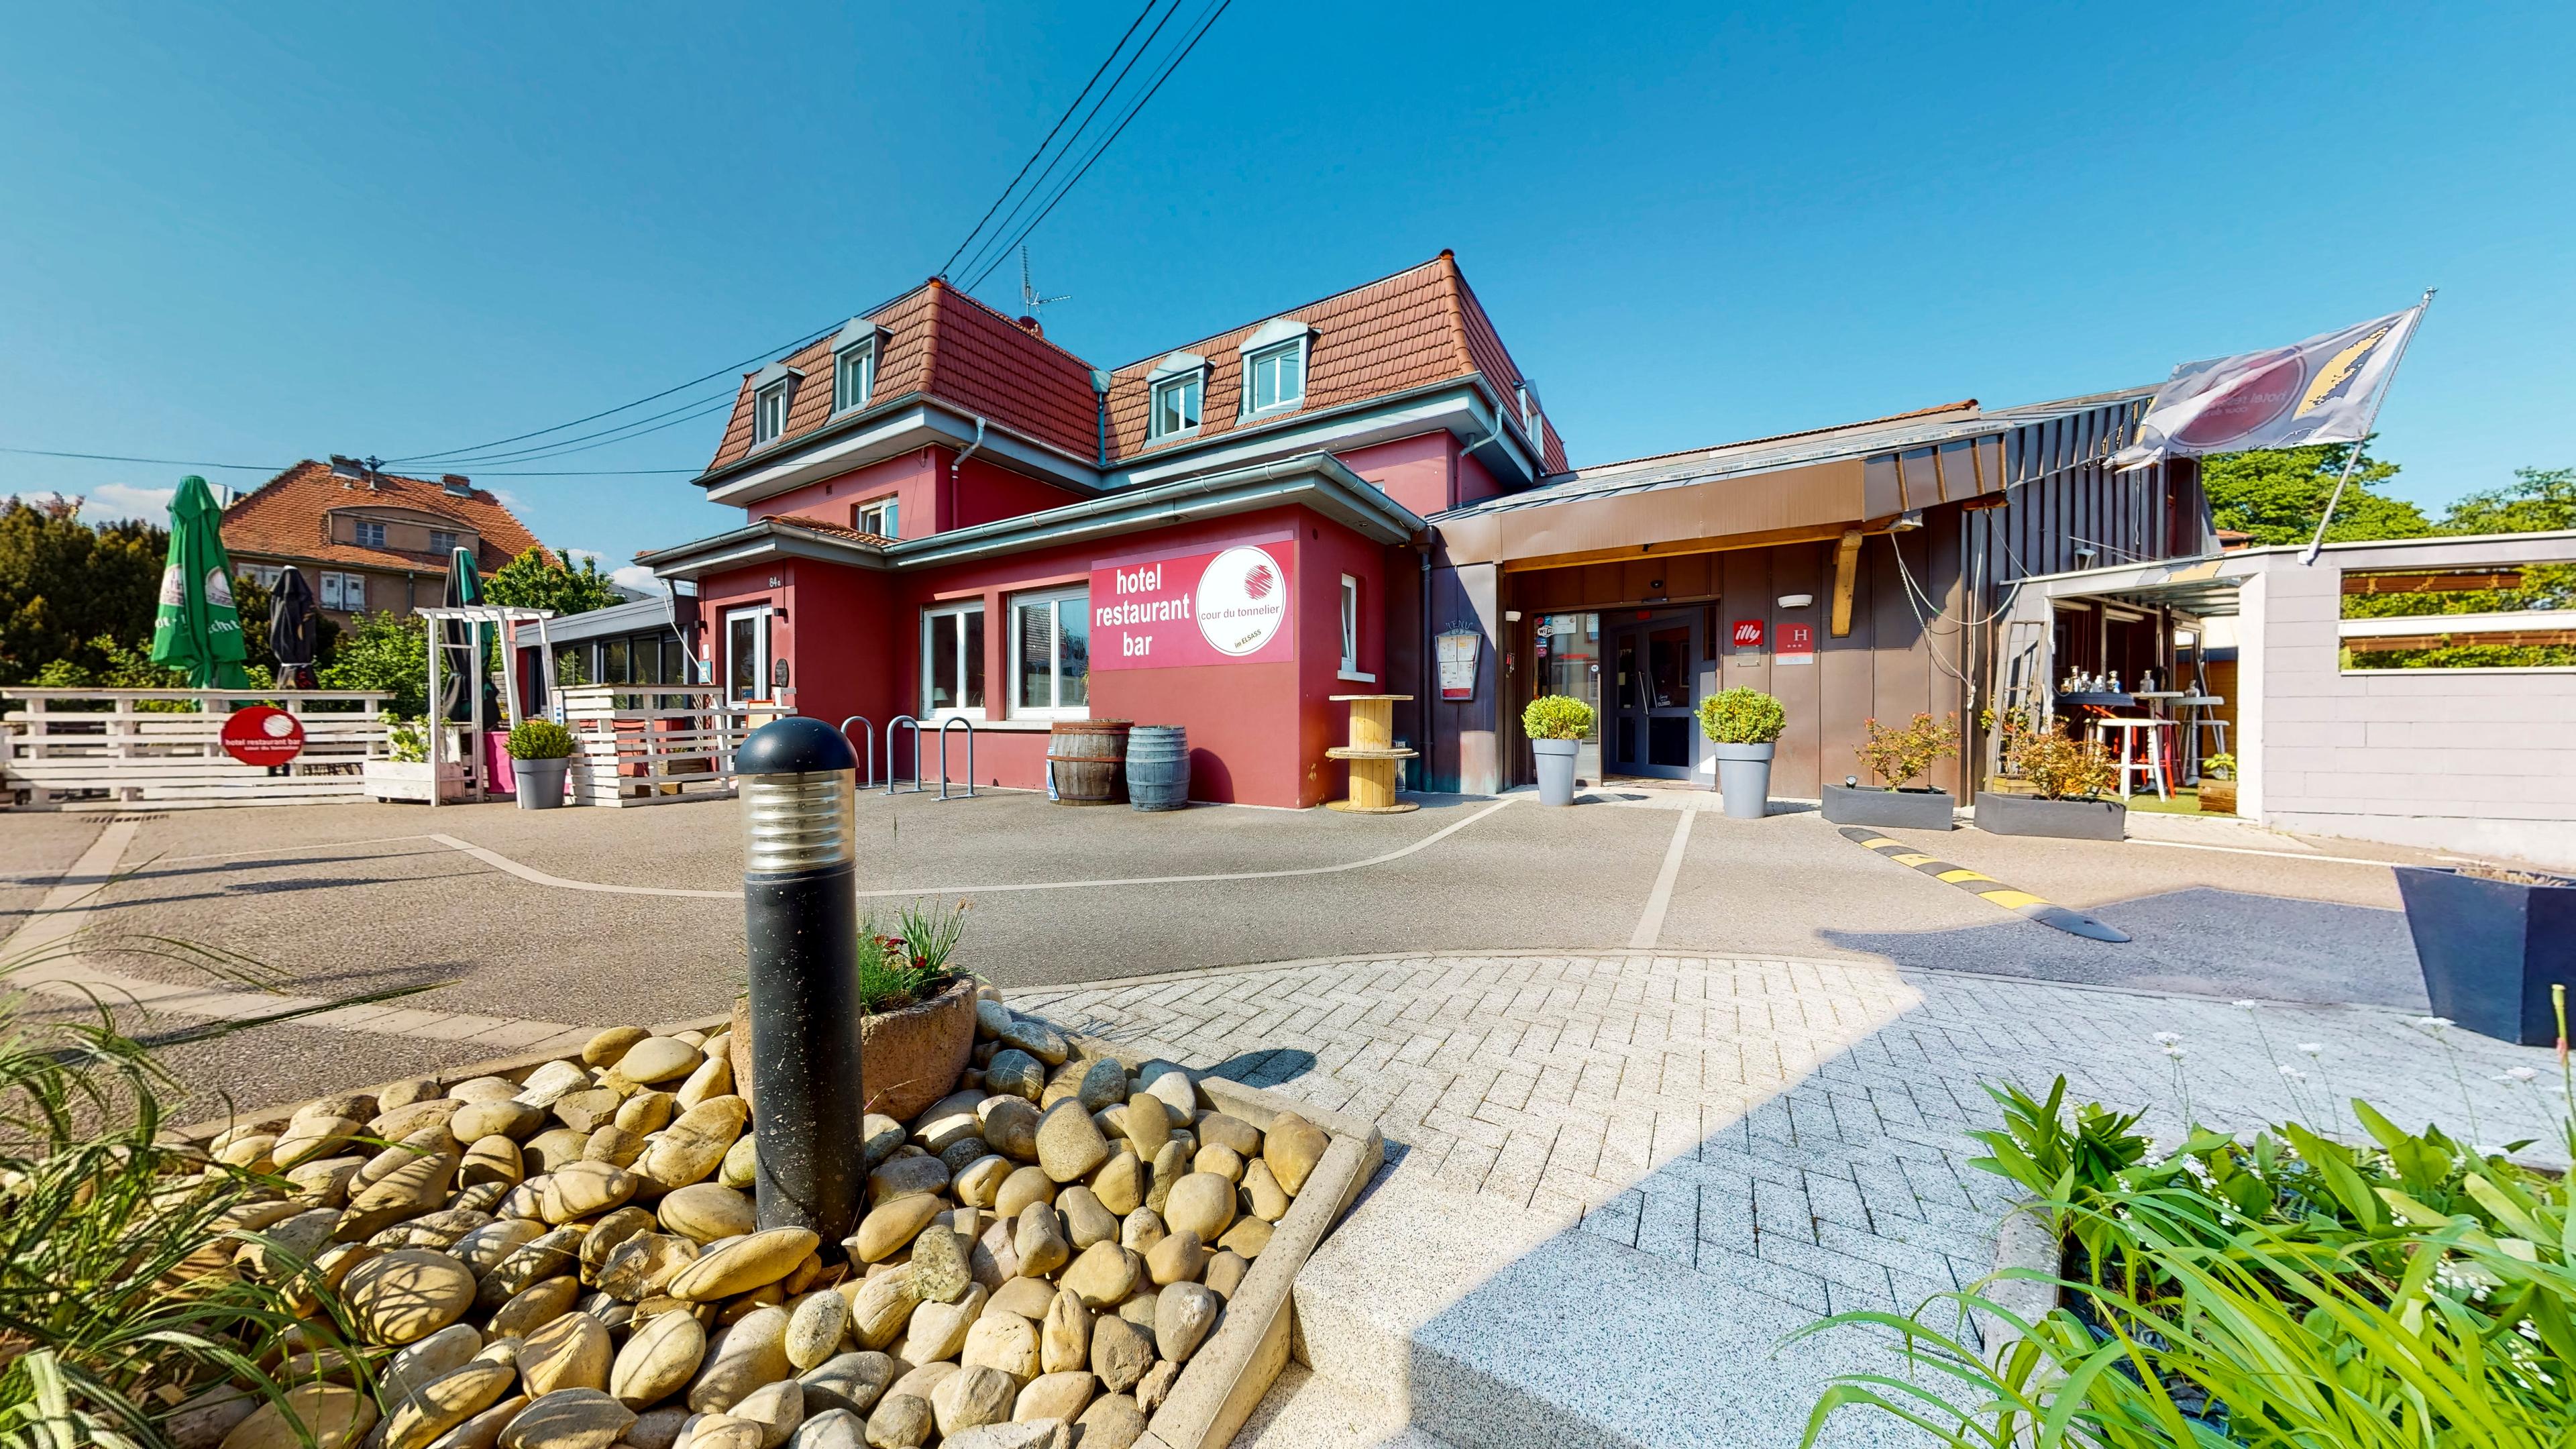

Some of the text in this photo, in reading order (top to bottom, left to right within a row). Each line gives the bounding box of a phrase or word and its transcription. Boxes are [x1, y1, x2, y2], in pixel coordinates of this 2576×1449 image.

[1116, 564, 1161, 594] hotel
[1096, 592, 1189, 627] restaurant
[1201, 604, 1280, 620] cour du tonnelier
[1241, 629, 1262, 644] ELSASS
[1735, 625, 1761, 643] illy
[1794, 629, 1807, 641] H
[1123, 631, 1152, 657] bar
